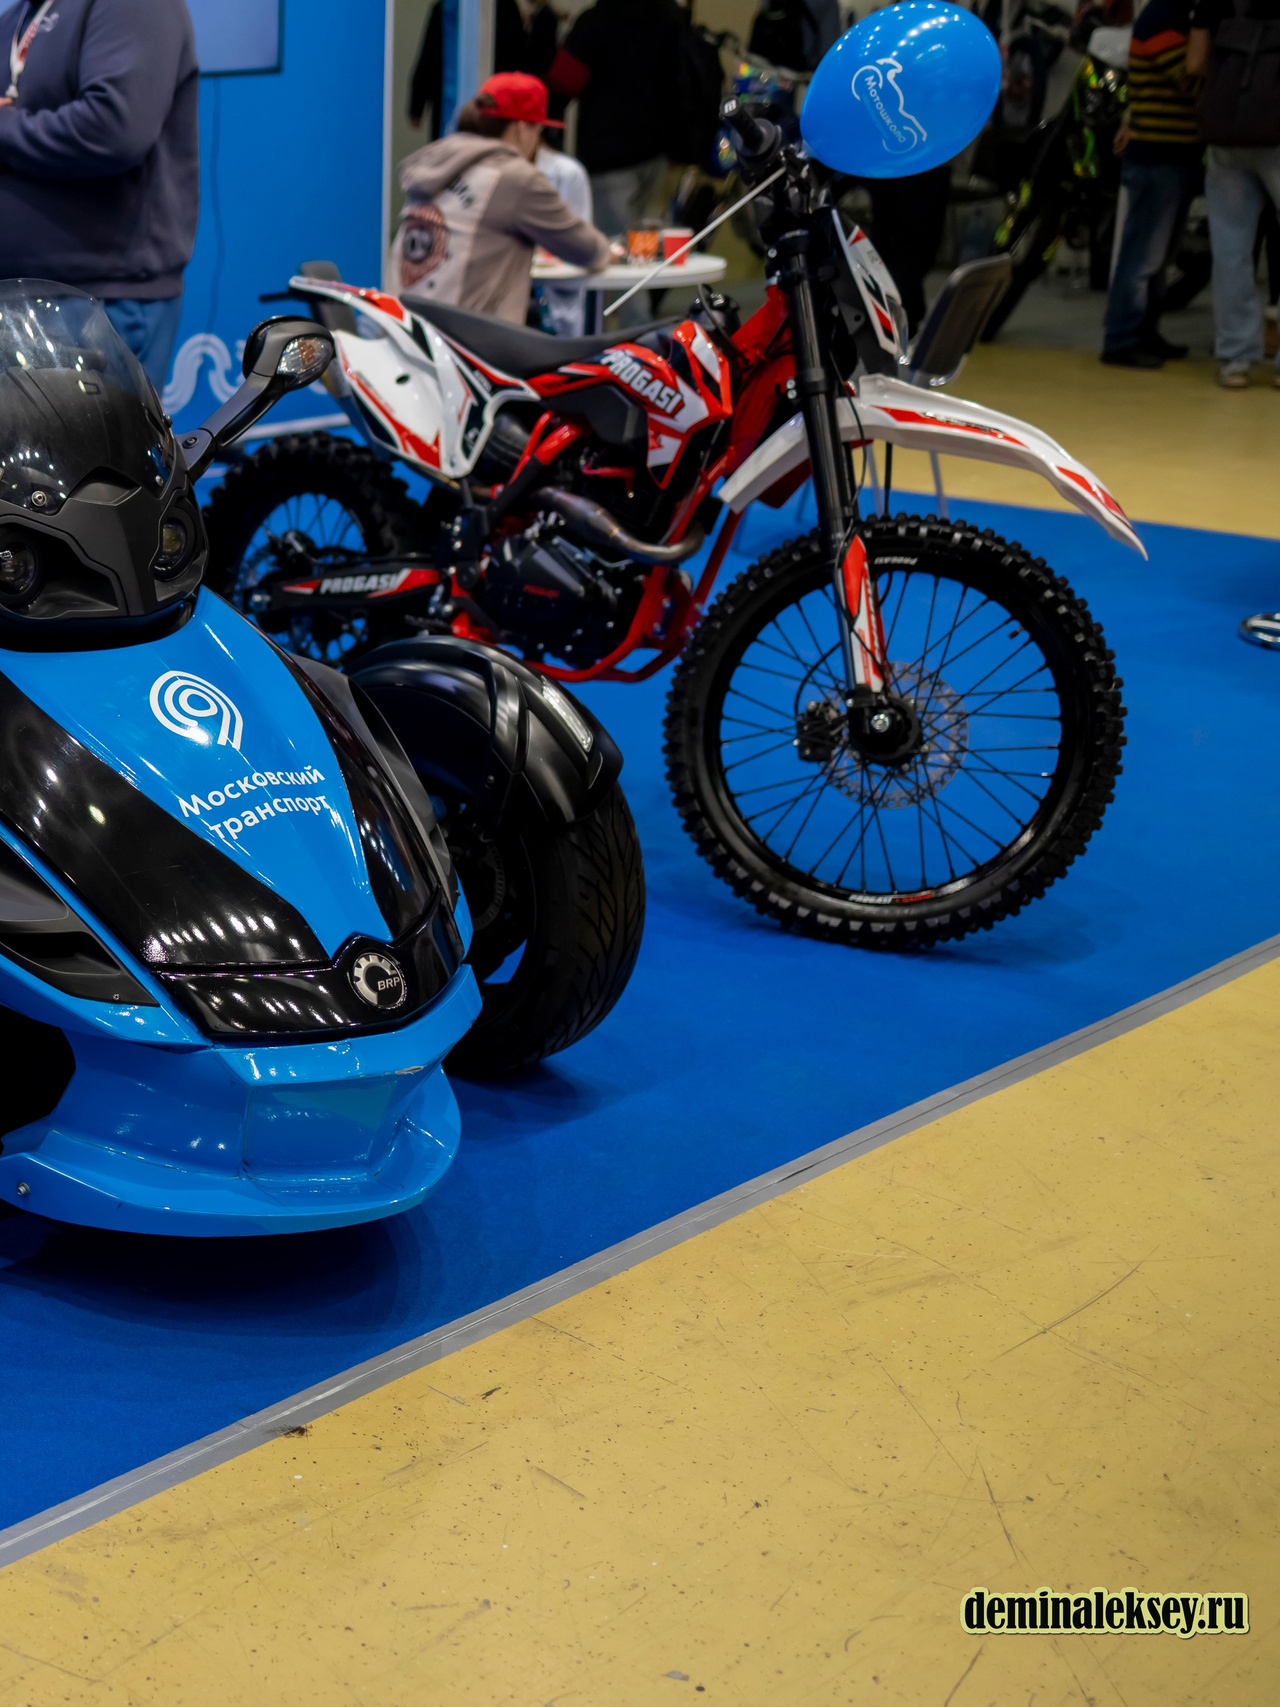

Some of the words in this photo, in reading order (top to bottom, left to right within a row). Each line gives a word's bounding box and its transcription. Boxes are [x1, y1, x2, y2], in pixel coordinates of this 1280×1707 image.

[600, 349, 683, 414] PROGASI
[320, 573, 401, 595] PROGASI
[178, 765, 326, 818] Московский
[210, 795, 328, 840] транспорт
[377, 976, 400, 991] BRP
